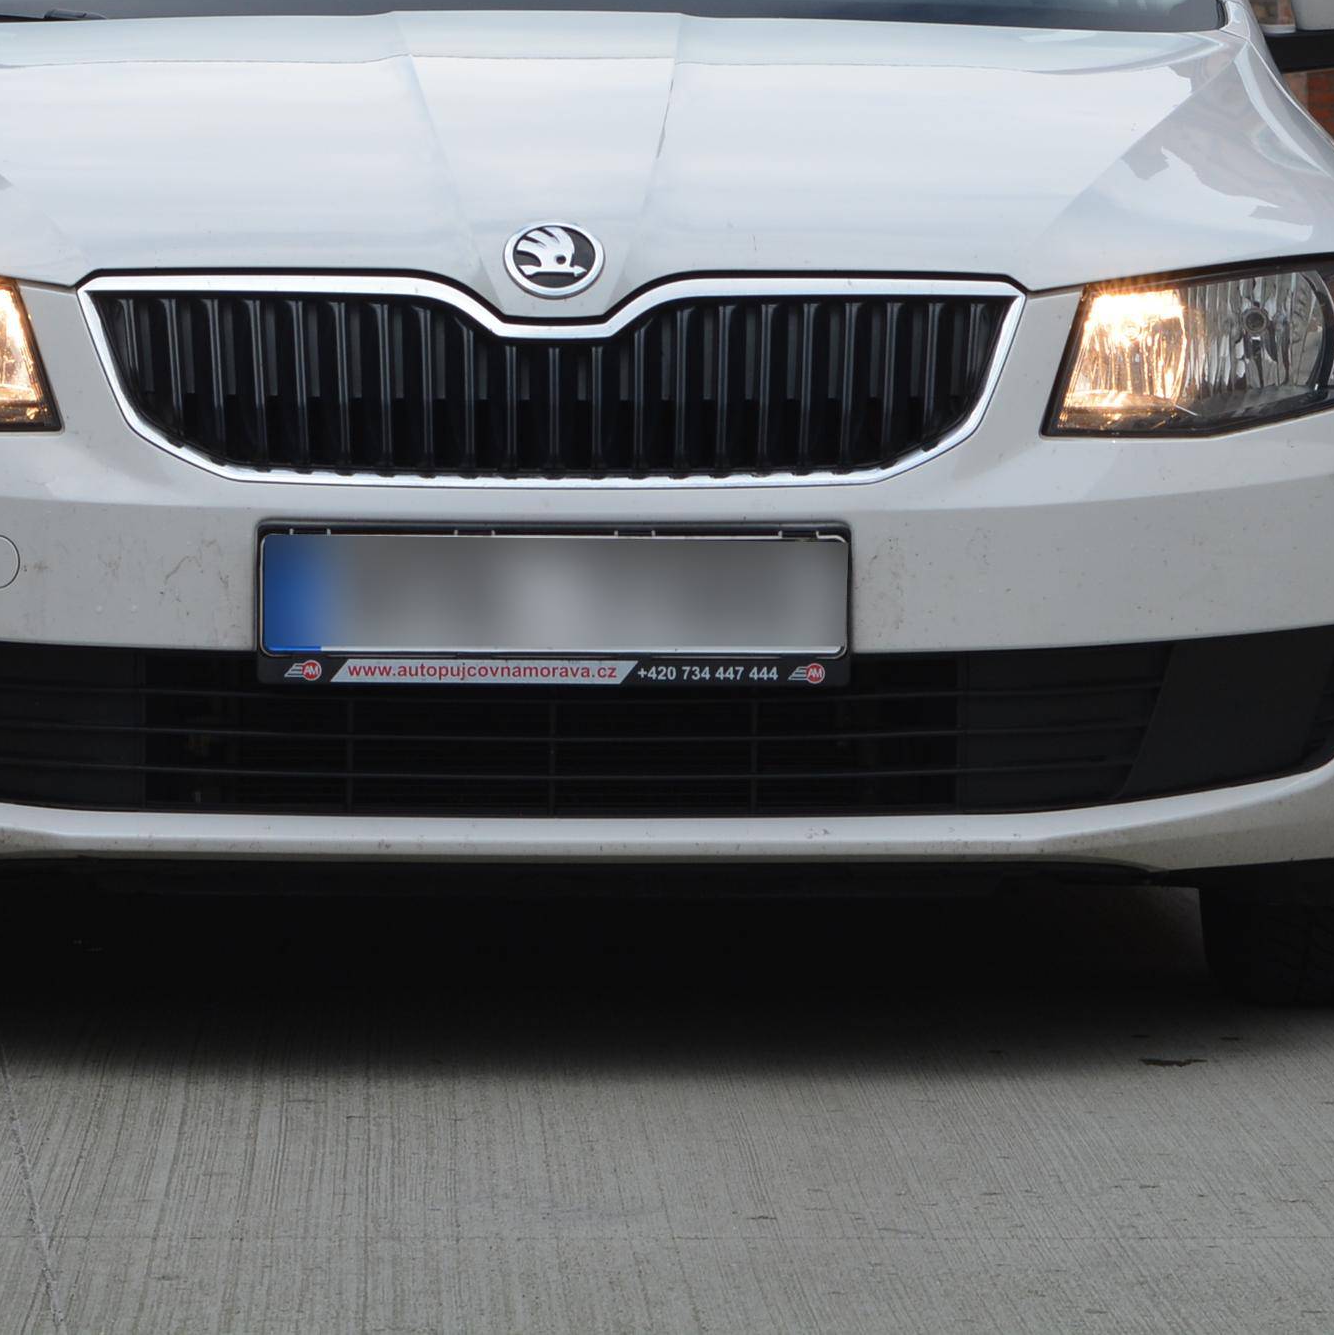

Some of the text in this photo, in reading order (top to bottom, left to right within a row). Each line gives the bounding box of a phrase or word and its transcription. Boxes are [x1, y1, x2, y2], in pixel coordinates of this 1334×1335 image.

[347, 663, 617, 681] www.autopujcovnamorava.cz
[637, 665, 779, 681] +420 734 447 444
